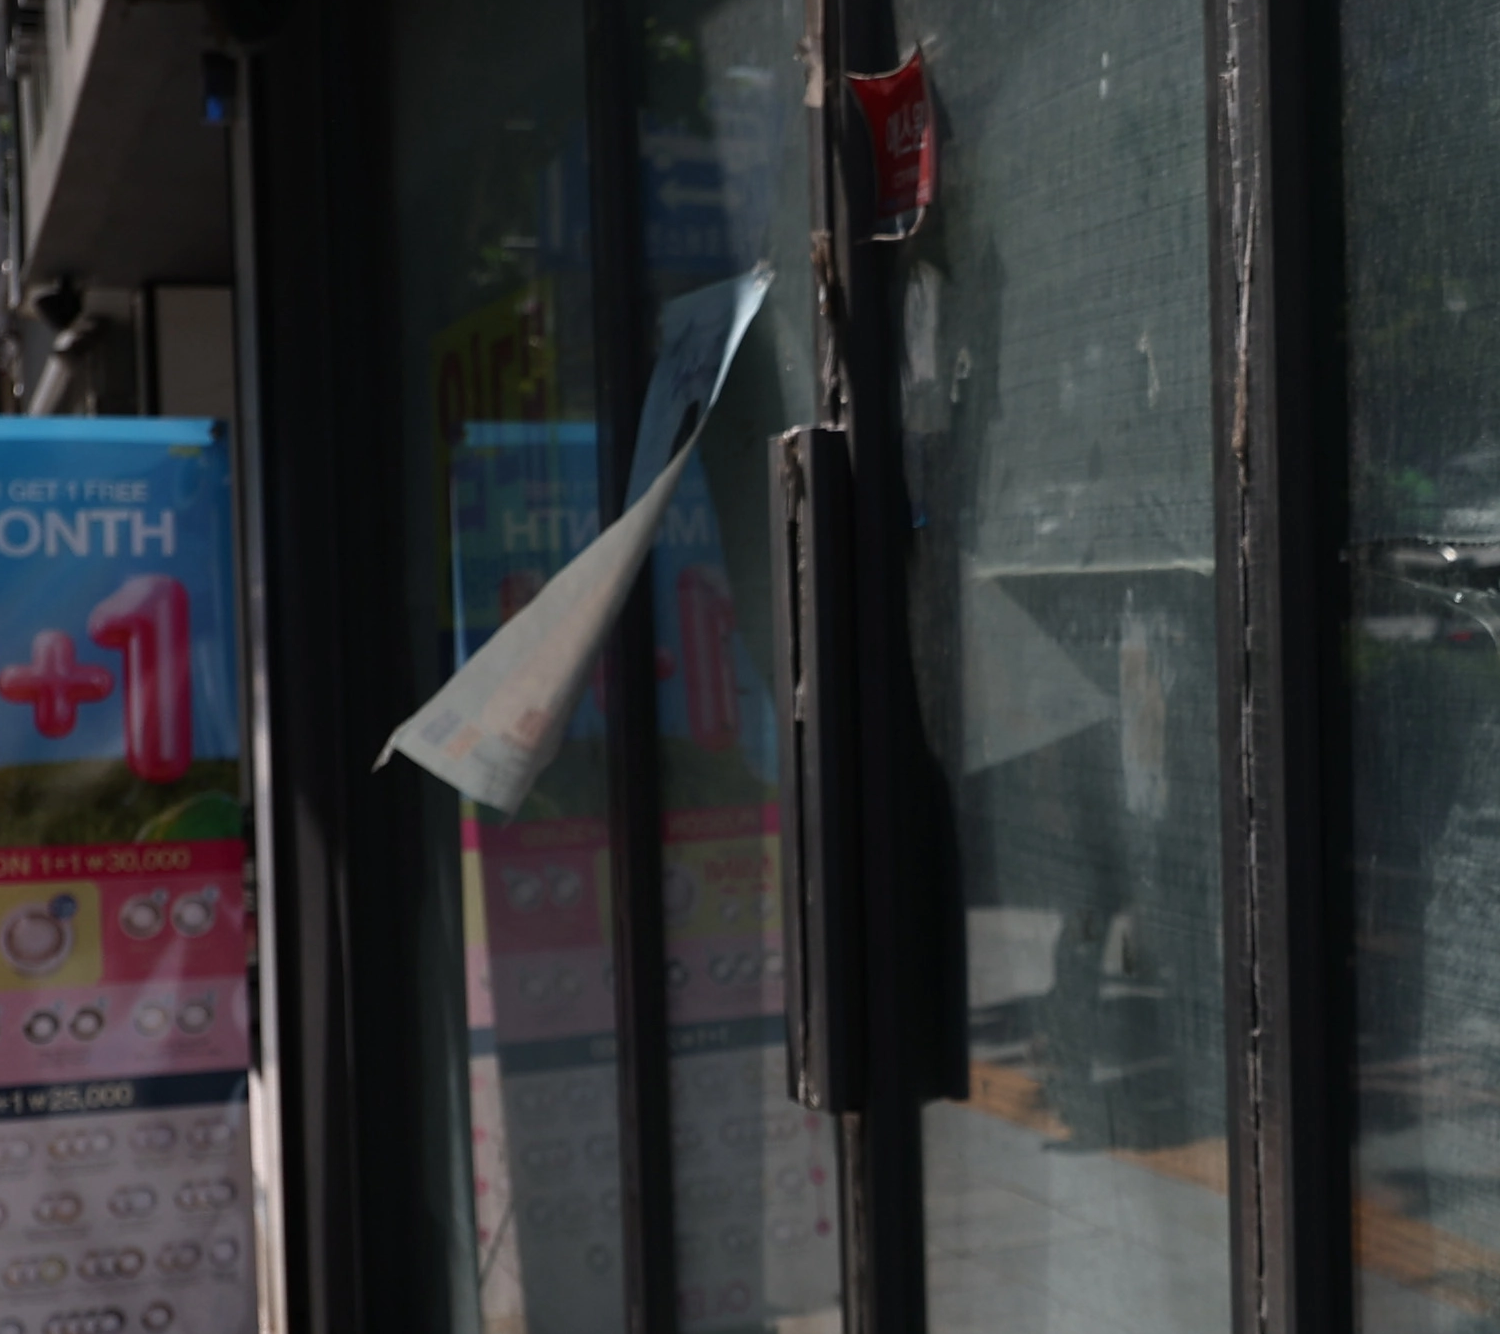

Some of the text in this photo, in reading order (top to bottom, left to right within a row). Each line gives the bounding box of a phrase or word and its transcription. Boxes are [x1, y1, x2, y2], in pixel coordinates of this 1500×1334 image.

[8, 479, 58, 502] GET
[66, 480, 78, 502] 1
[83, 479, 149, 503] FREE
